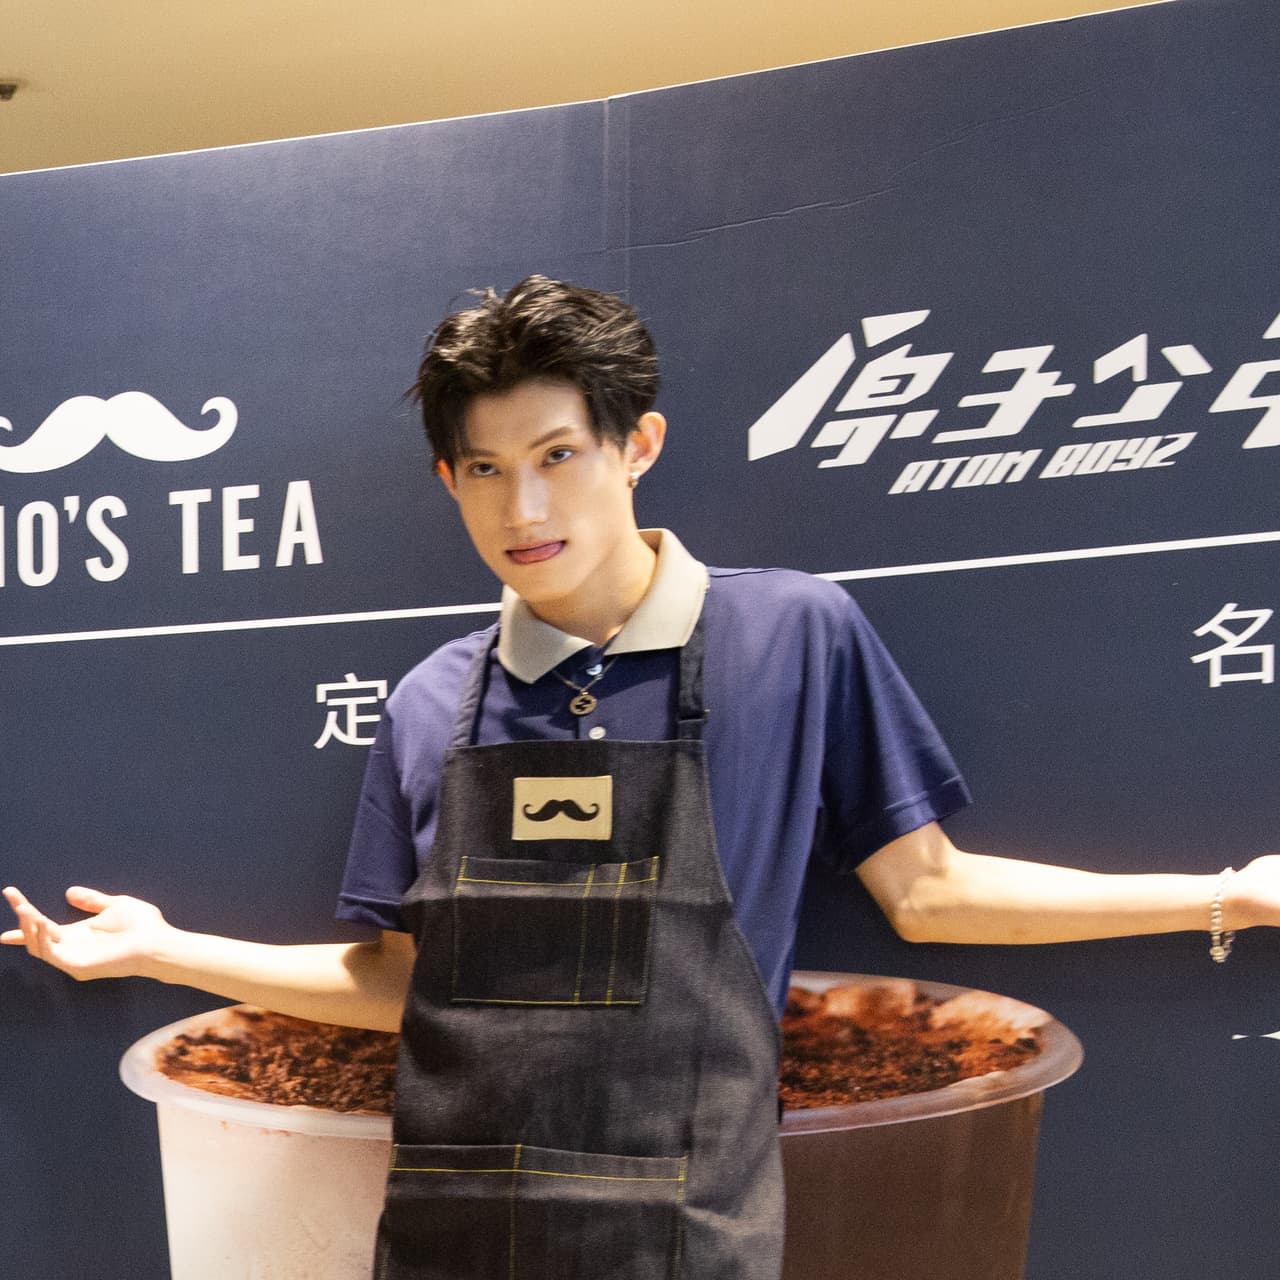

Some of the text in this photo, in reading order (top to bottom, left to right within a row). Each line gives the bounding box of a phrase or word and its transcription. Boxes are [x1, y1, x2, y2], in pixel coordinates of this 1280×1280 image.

[888, 431, 1197, 495] ATOM BOYZ
[168, 480, 324, 575] TEA
[312, 673, 389, 750] 定
[1190, 602, 1275, 689] 名
